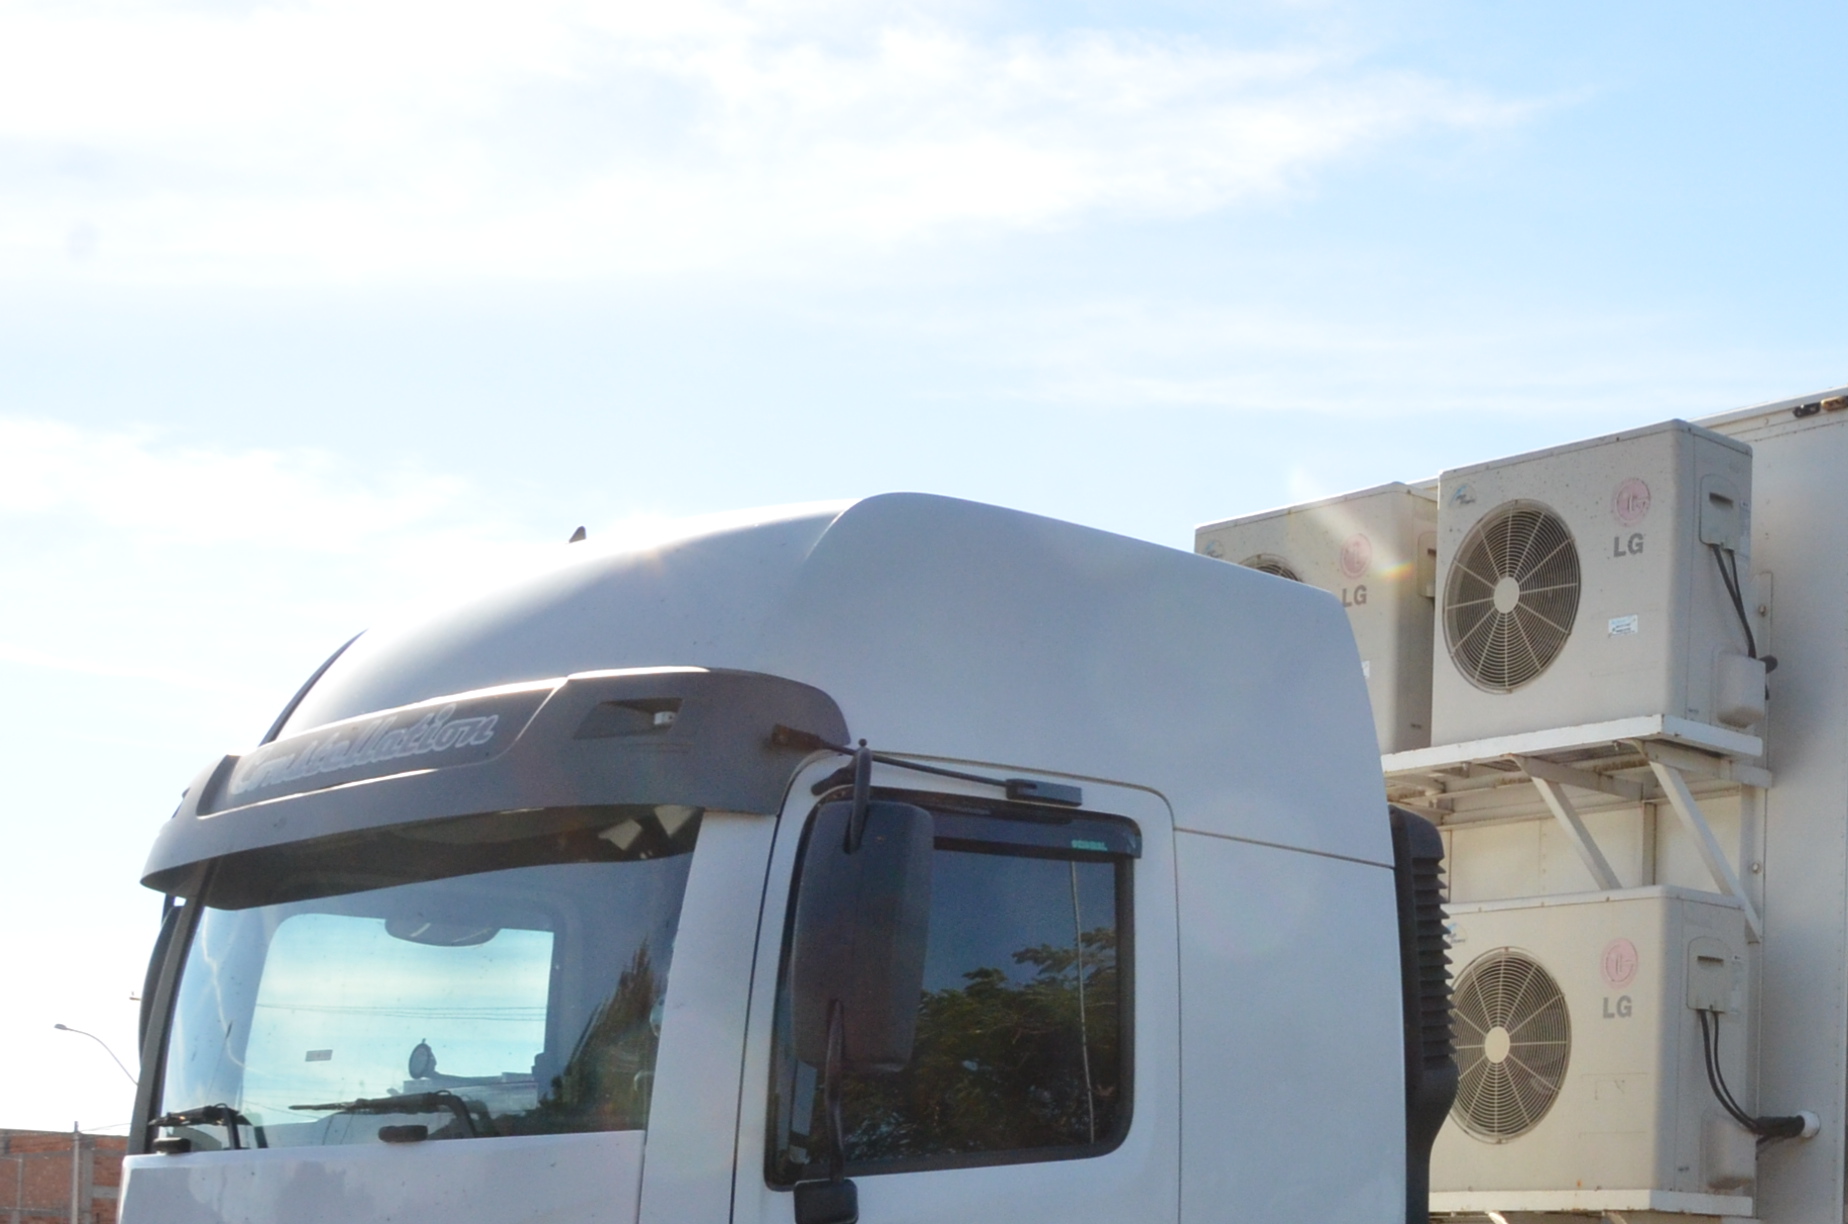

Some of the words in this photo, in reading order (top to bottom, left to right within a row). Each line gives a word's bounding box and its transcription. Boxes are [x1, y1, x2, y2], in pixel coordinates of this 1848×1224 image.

[1614, 533, 1645, 558] LG
[1341, 585, 1368, 607] LG
[1602, 995, 1633, 1019] LG
